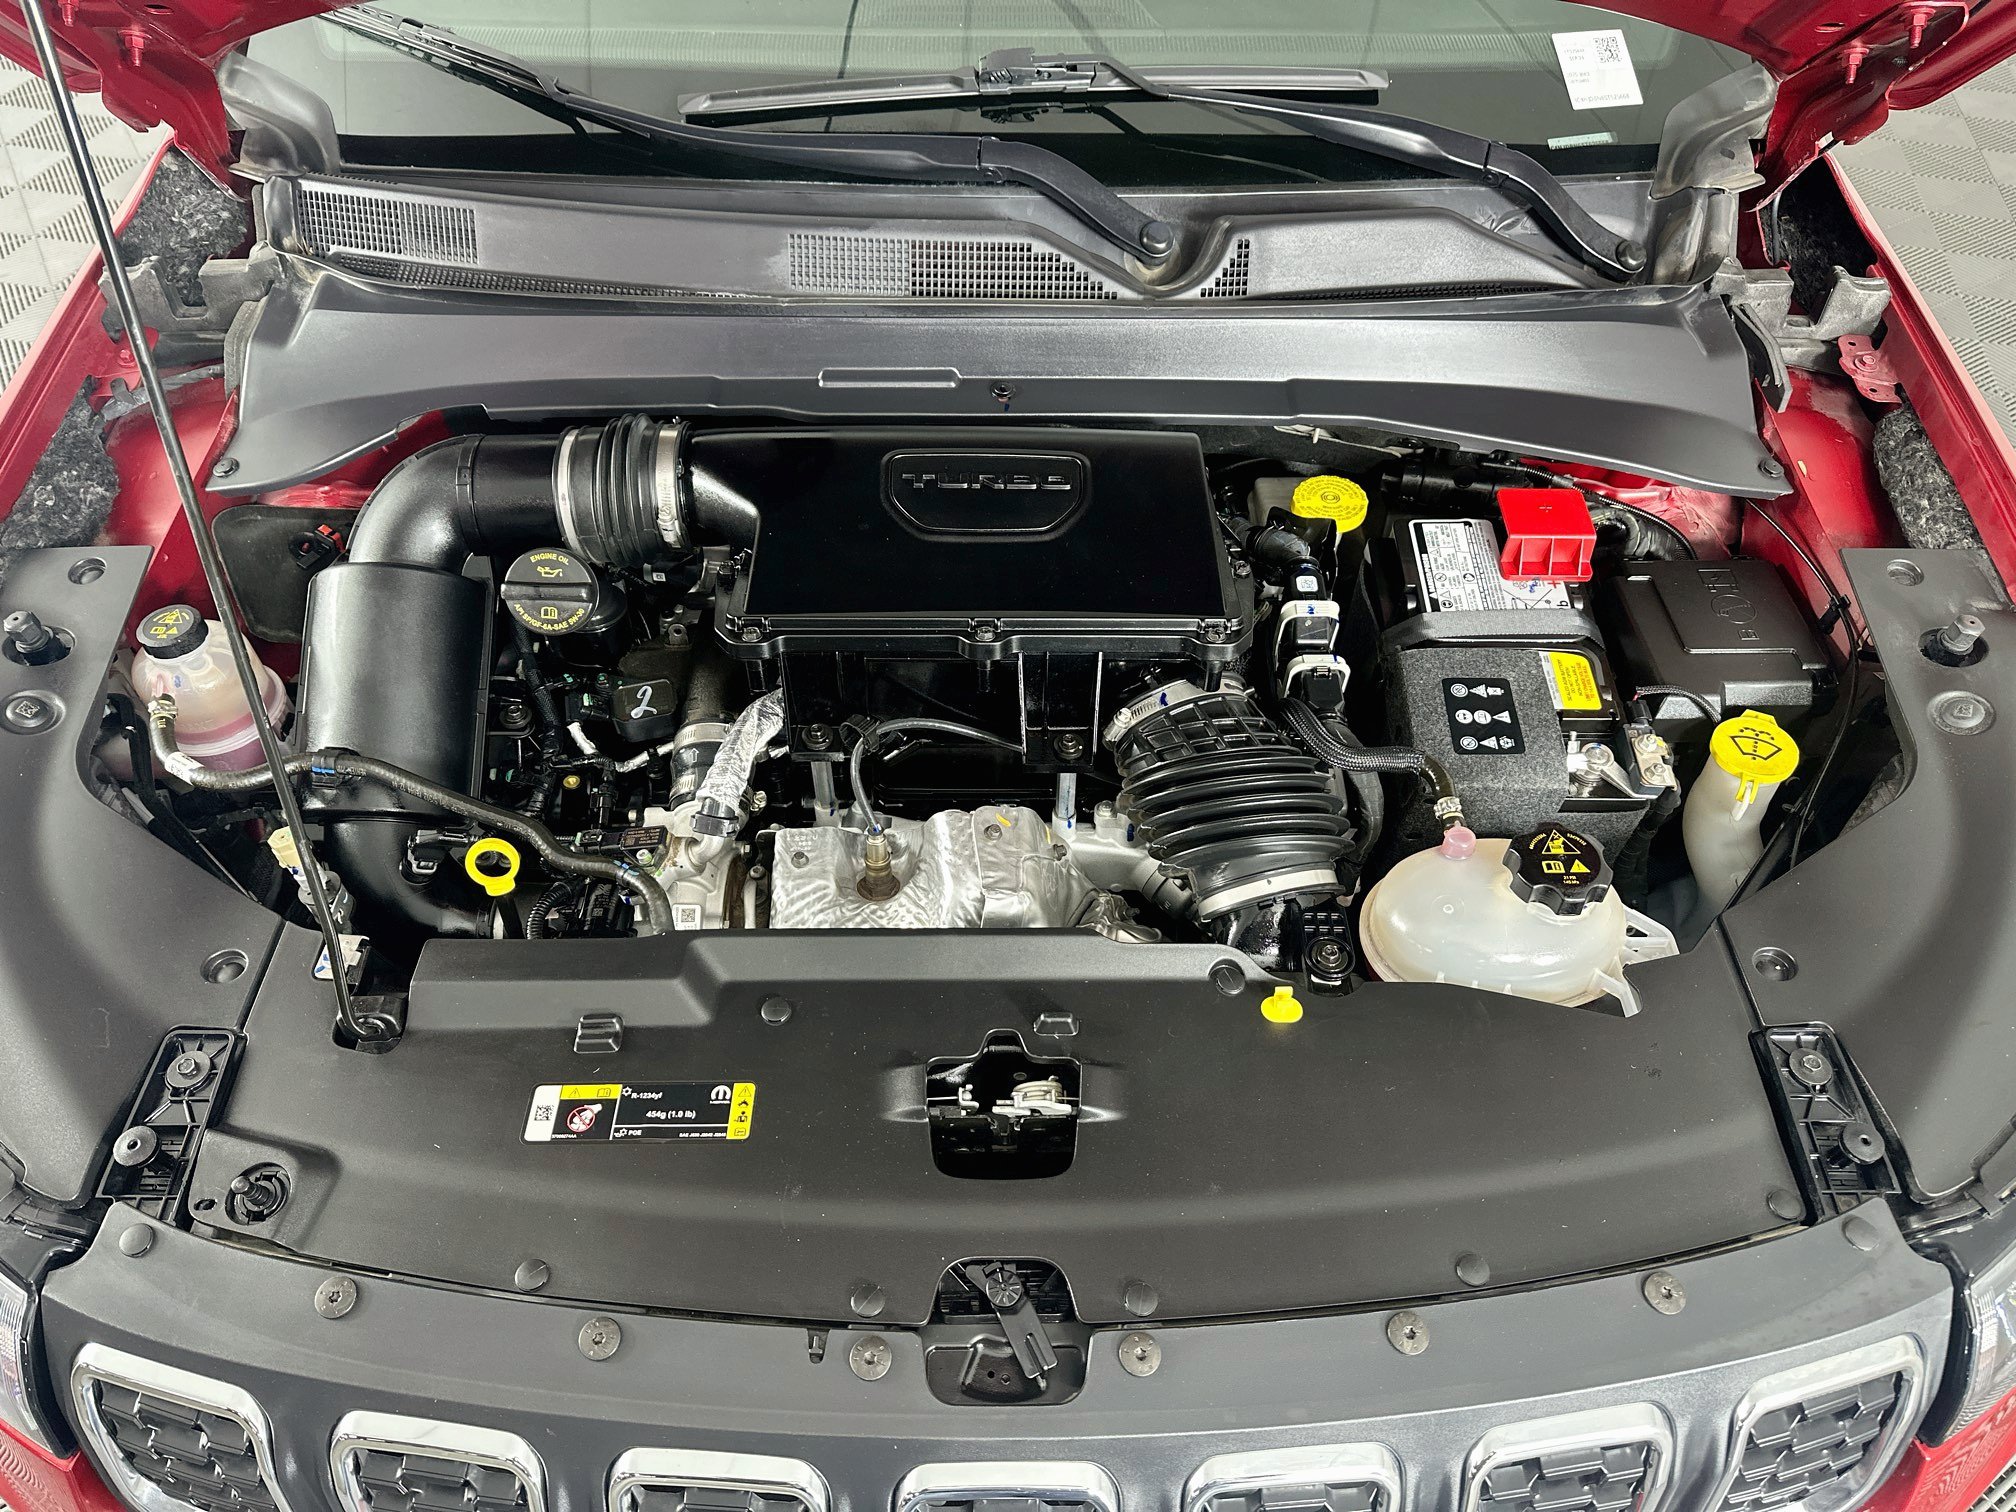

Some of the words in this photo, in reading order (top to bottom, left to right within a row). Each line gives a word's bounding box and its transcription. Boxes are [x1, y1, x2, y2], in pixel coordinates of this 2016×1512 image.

[901, 472, 1072, 490] TURBO
[530, 552, 557, 562] ENGINE
[558, 556, 569, 565] OIL
[514, 603, 524, 616] API
[568, 608, 585, 625] 5W-30
[1556, 659, 1566, 676] BATTERY
[630, 685, 658, 718] 2
[631, 1092, 662, 1100] R-1234yf
[646, 1110, 666, 1120] 454g
[668, 1110, 683, 1120] (1.0
[684, 1110, 696, 1120] lb)
